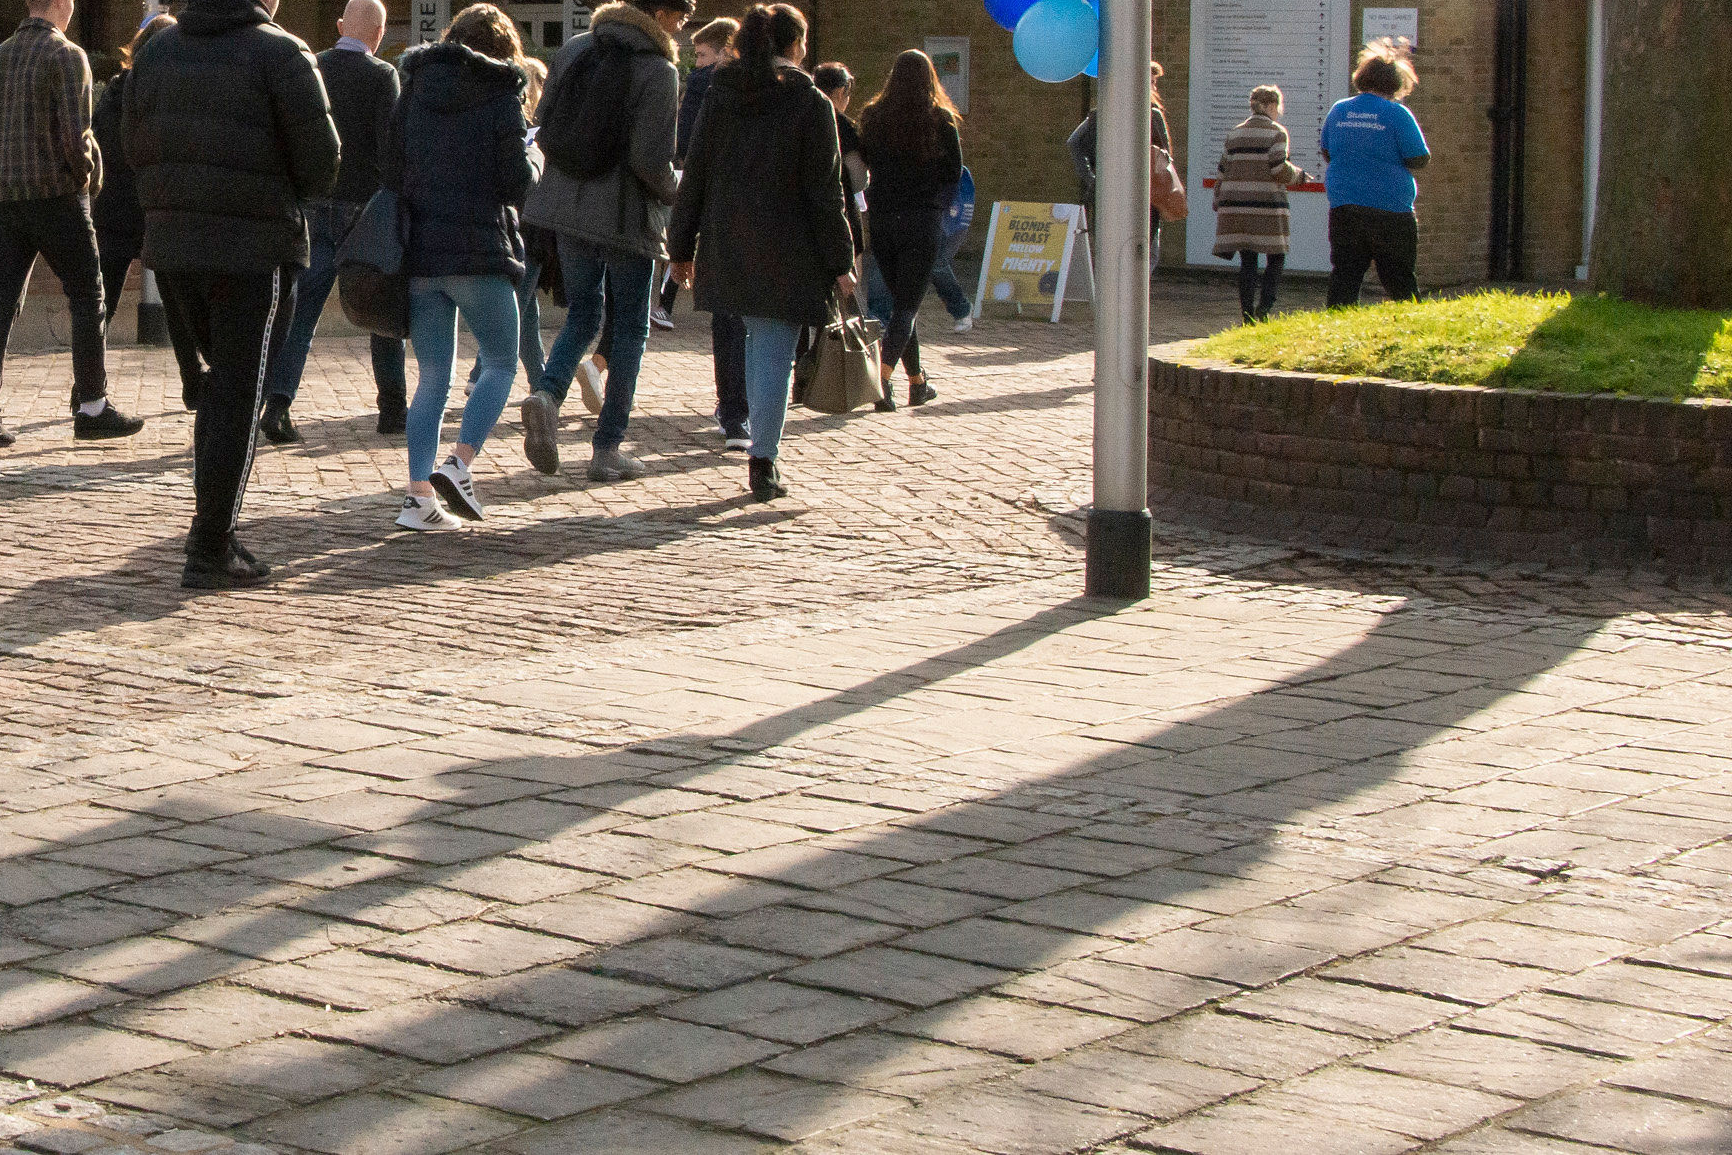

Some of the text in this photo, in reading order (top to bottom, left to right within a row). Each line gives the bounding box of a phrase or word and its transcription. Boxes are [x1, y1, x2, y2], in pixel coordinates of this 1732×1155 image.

[1346, 111, 1378, 120] Student
[1336, 120, 1386, 132] Ambassador
[1008, 220, 1053, 232] BLONDE
[1012, 232, 1052, 244] ROAST
[1008, 243, 1045, 254] MELLOW
[1001, 256, 1056, 272] MIGHTY
